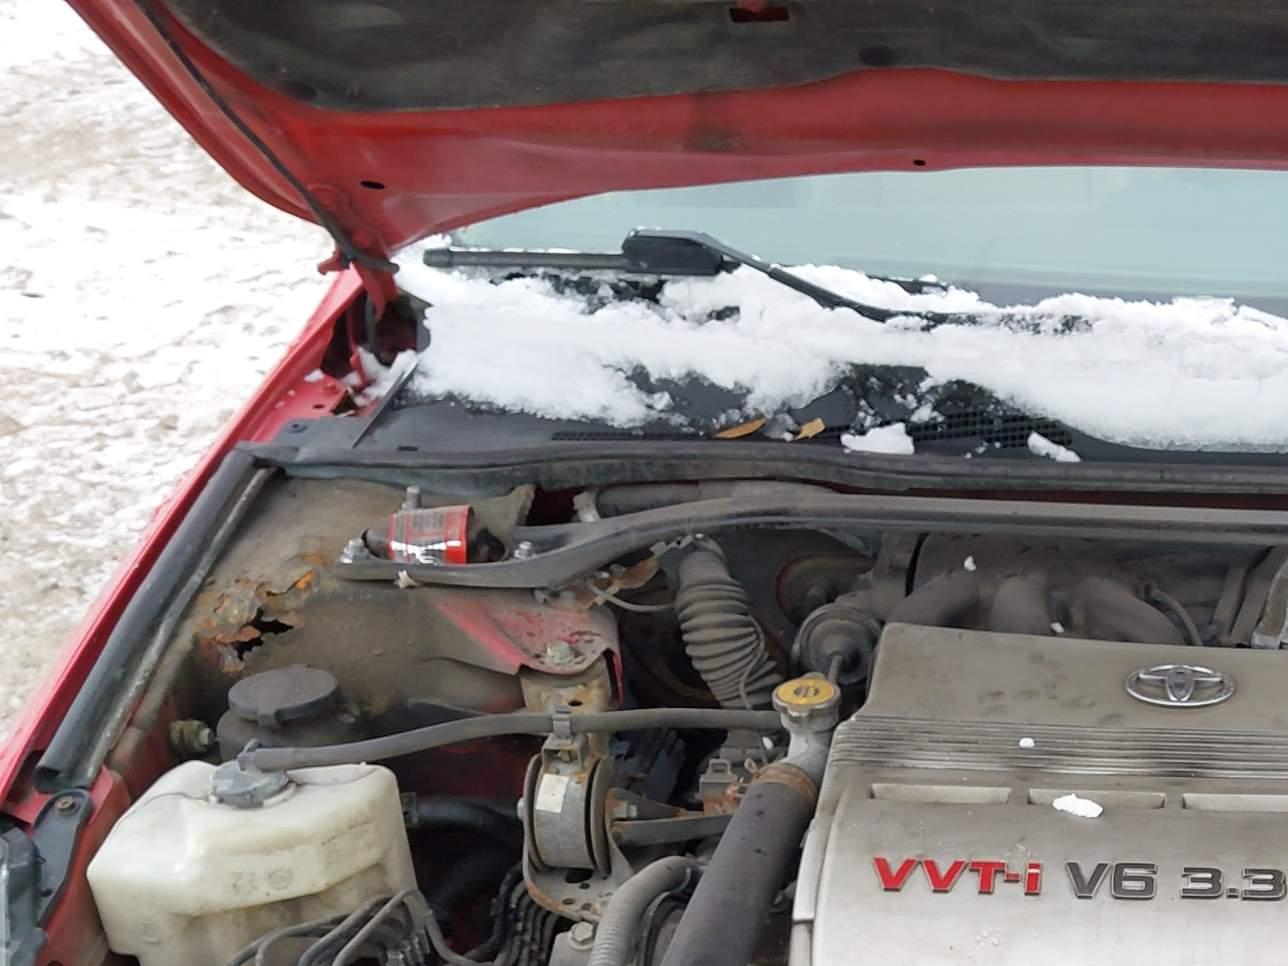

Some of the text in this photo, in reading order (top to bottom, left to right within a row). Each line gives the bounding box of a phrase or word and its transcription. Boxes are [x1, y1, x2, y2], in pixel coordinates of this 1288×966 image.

[872, 856, 1288, 900] VVT-i V6 3.3
